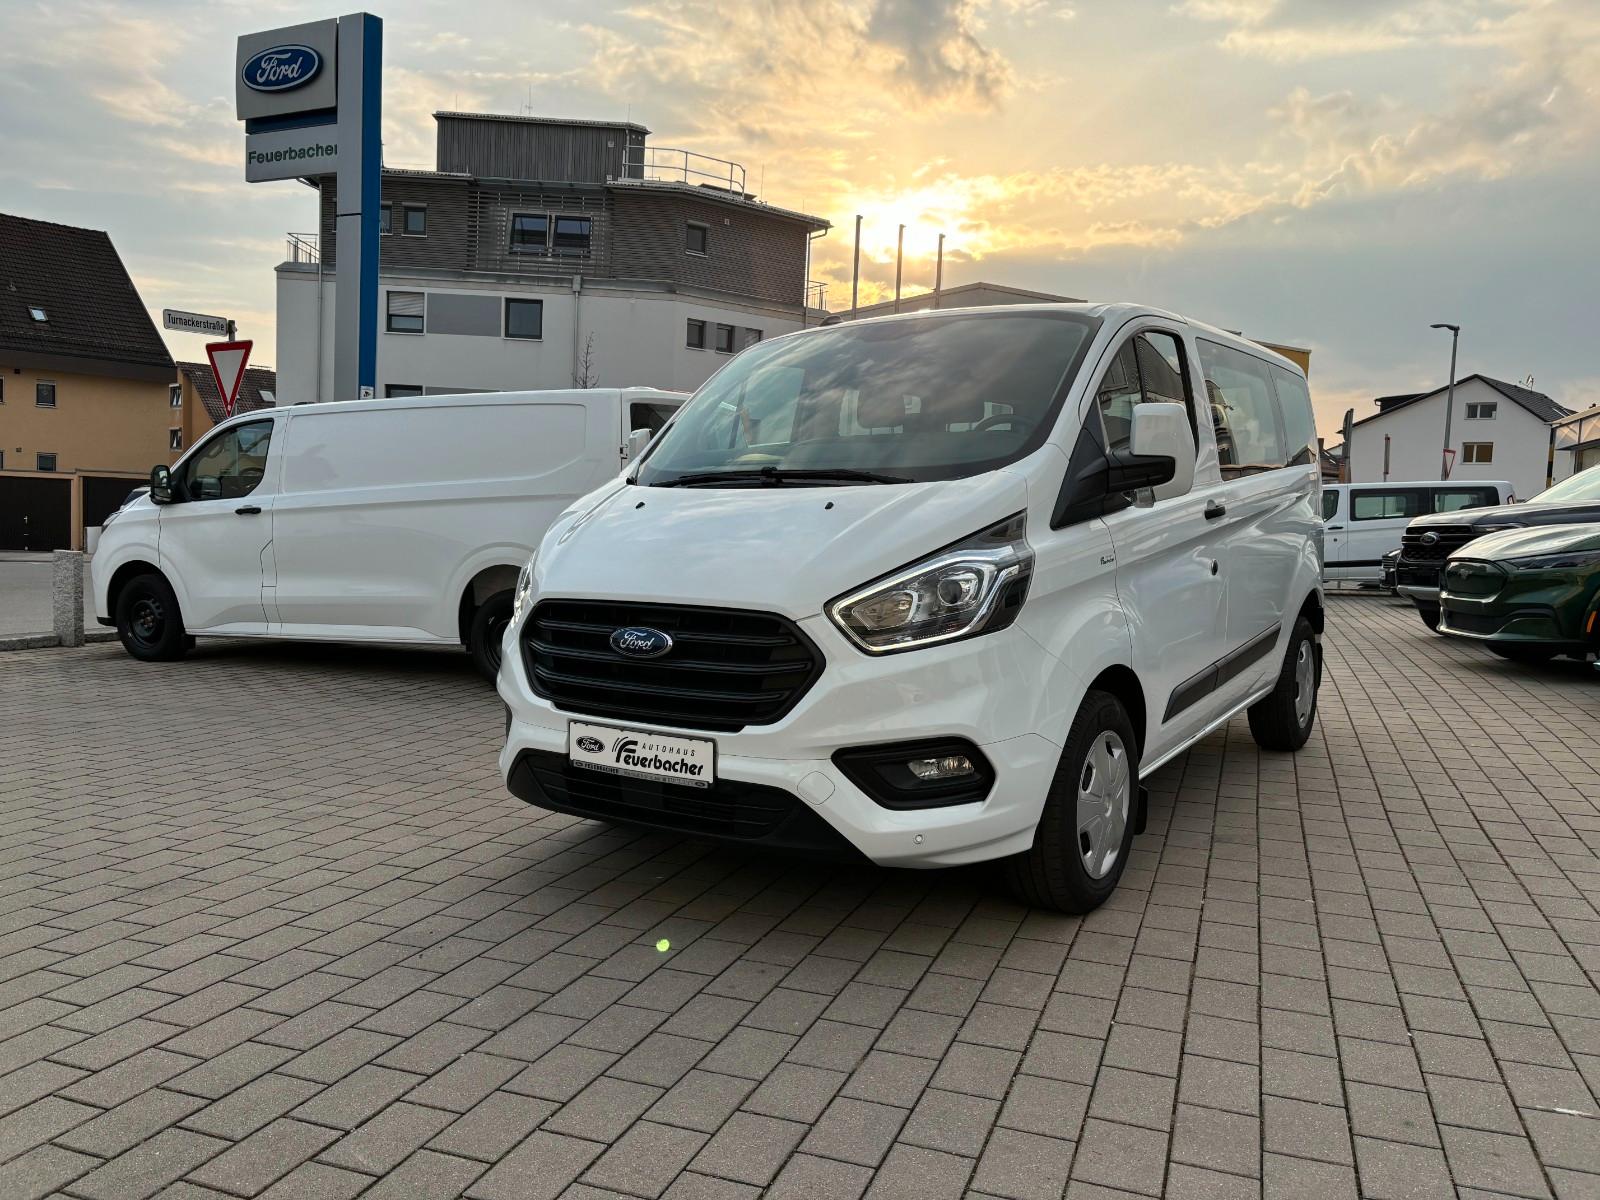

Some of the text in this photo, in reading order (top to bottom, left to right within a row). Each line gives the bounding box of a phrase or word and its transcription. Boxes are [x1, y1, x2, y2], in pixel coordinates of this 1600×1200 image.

[256, 52, 302, 83] Ford
[167, 313, 225, 331] Turnackerstraße
[620, 630, 655, 650] Ford
[581, 739, 600, 750] Ford
[641, 742, 696, 757] AUTOHAUS
[615, 738, 704, 776] Feuerbacher
